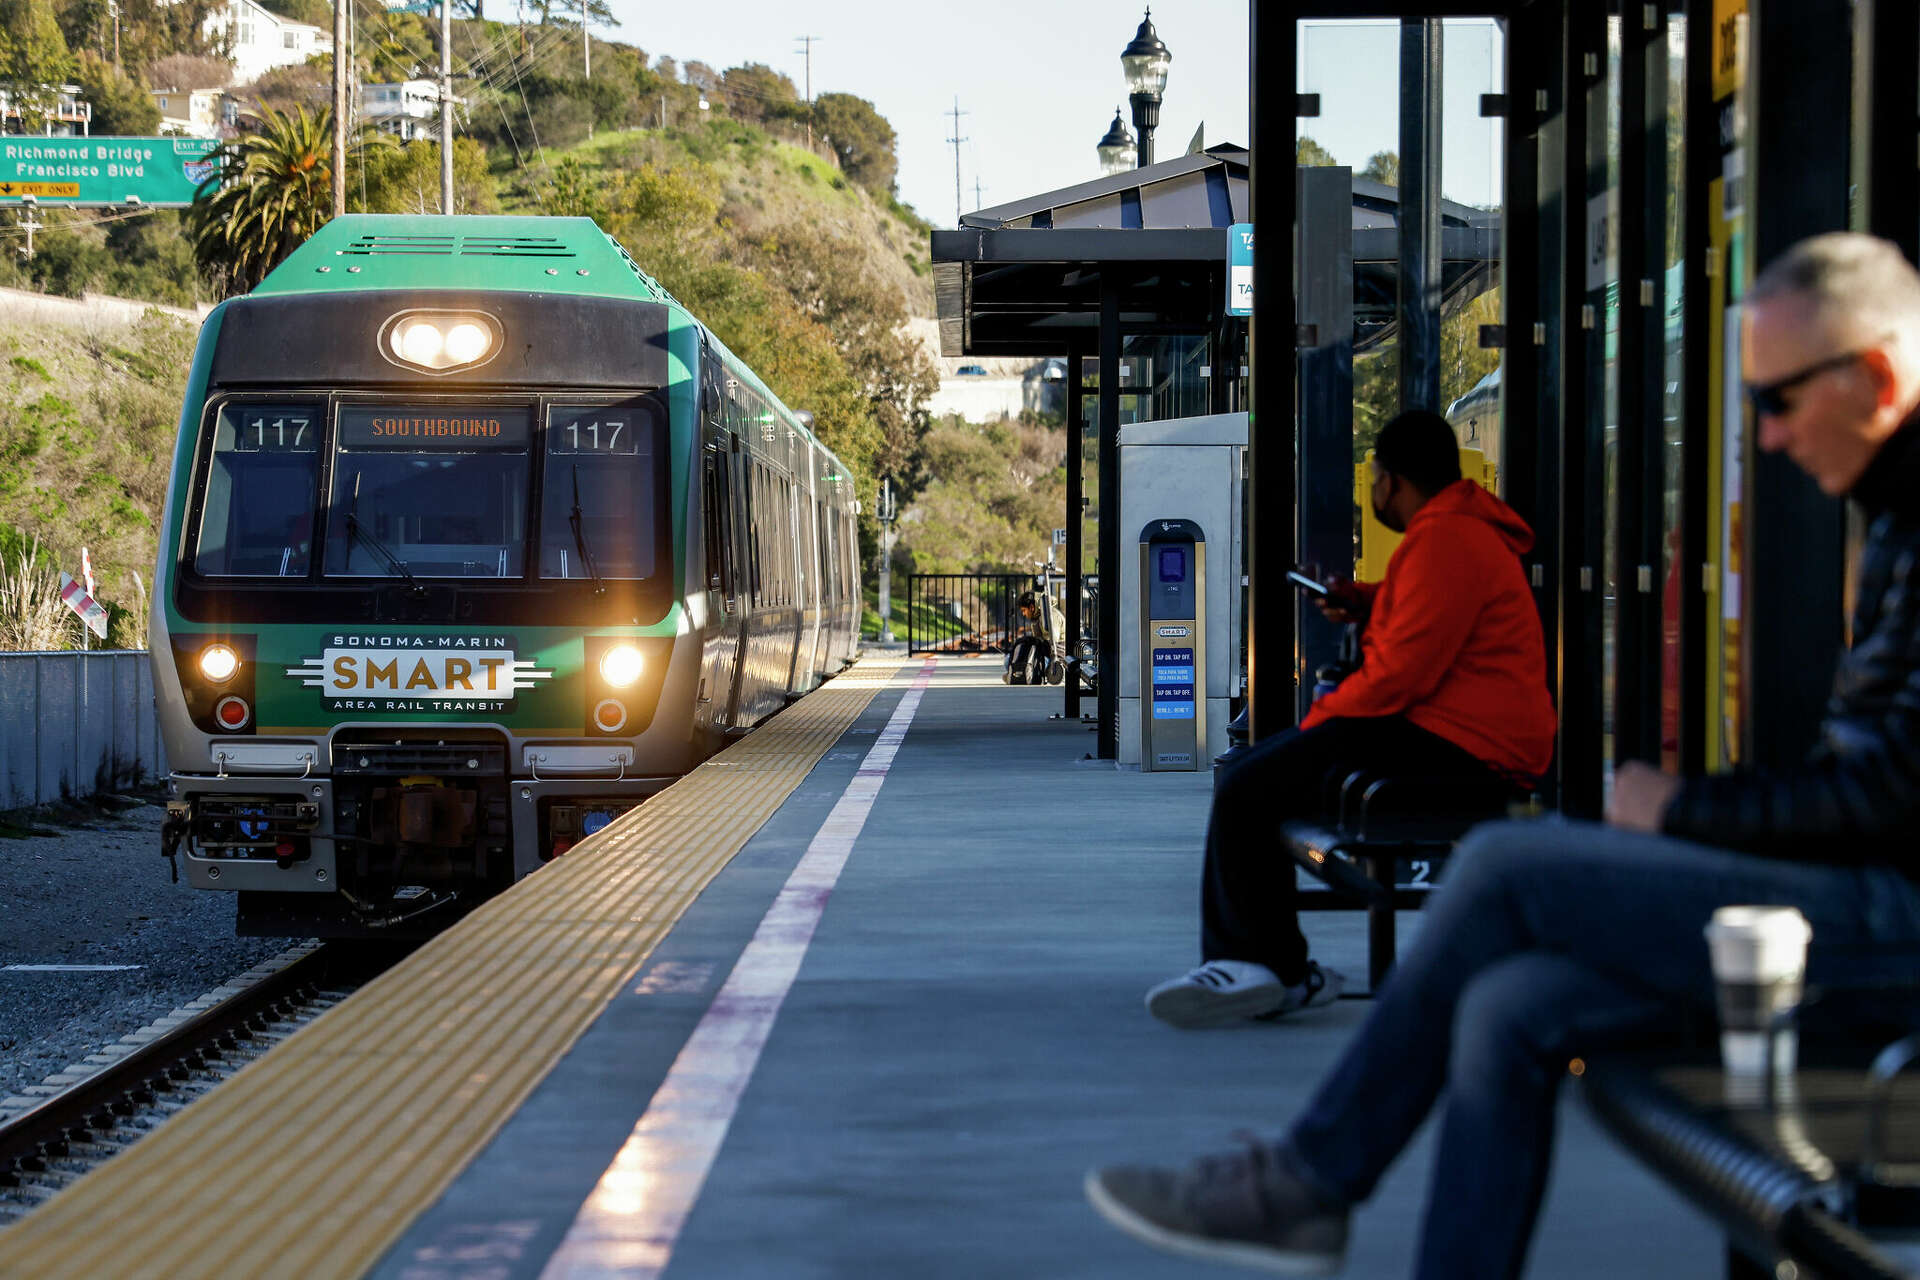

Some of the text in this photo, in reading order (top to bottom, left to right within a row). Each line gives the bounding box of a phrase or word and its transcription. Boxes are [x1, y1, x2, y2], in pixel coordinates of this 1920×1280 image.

[5, 144, 153, 164] Richmond Bridge
[16, 162, 145, 177] Francisco Blvd
[21, 184, 74, 194] EXIT ONLY
[251, 418, 310, 447] 117
[371, 417, 501, 437] SOUTHBOUND
[566, 421, 625, 449] 117
[332, 655, 506, 692] SMART
[333, 701, 506, 712] AREA RAIL TRANSIT
[1411, 861, 1430, 888] 2
